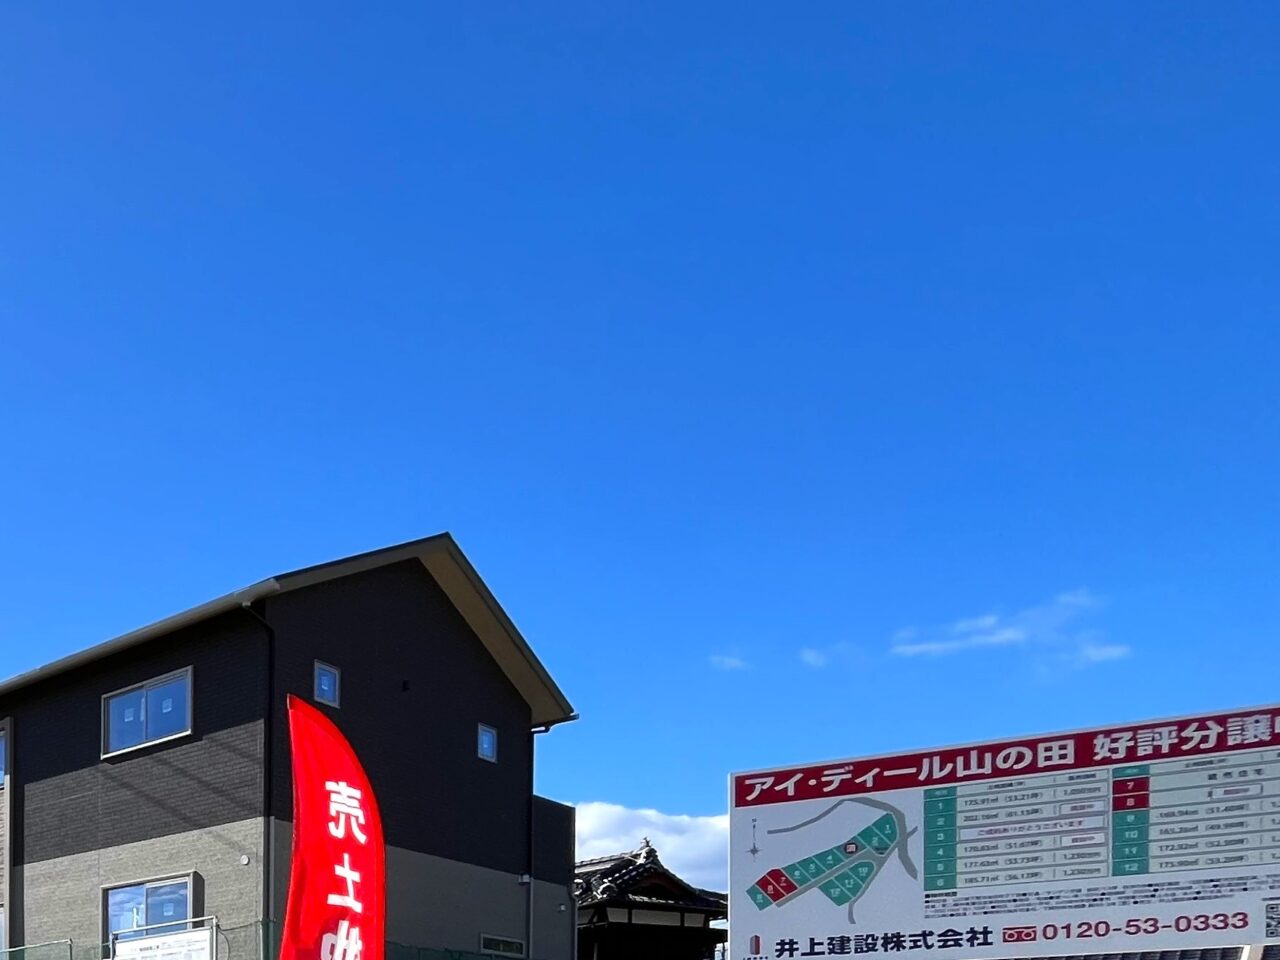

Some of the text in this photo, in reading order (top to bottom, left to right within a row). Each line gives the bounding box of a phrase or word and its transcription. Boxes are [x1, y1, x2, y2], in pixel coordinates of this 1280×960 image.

[744, 713, 1280, 801] アイ・ディール山の田 好評分譲
[1126, 782, 1134, 790] 7
[1126, 798, 1135, 806] 8
[775, 911, 1249, 958] 井上建設株式会社 0120-53-0333
